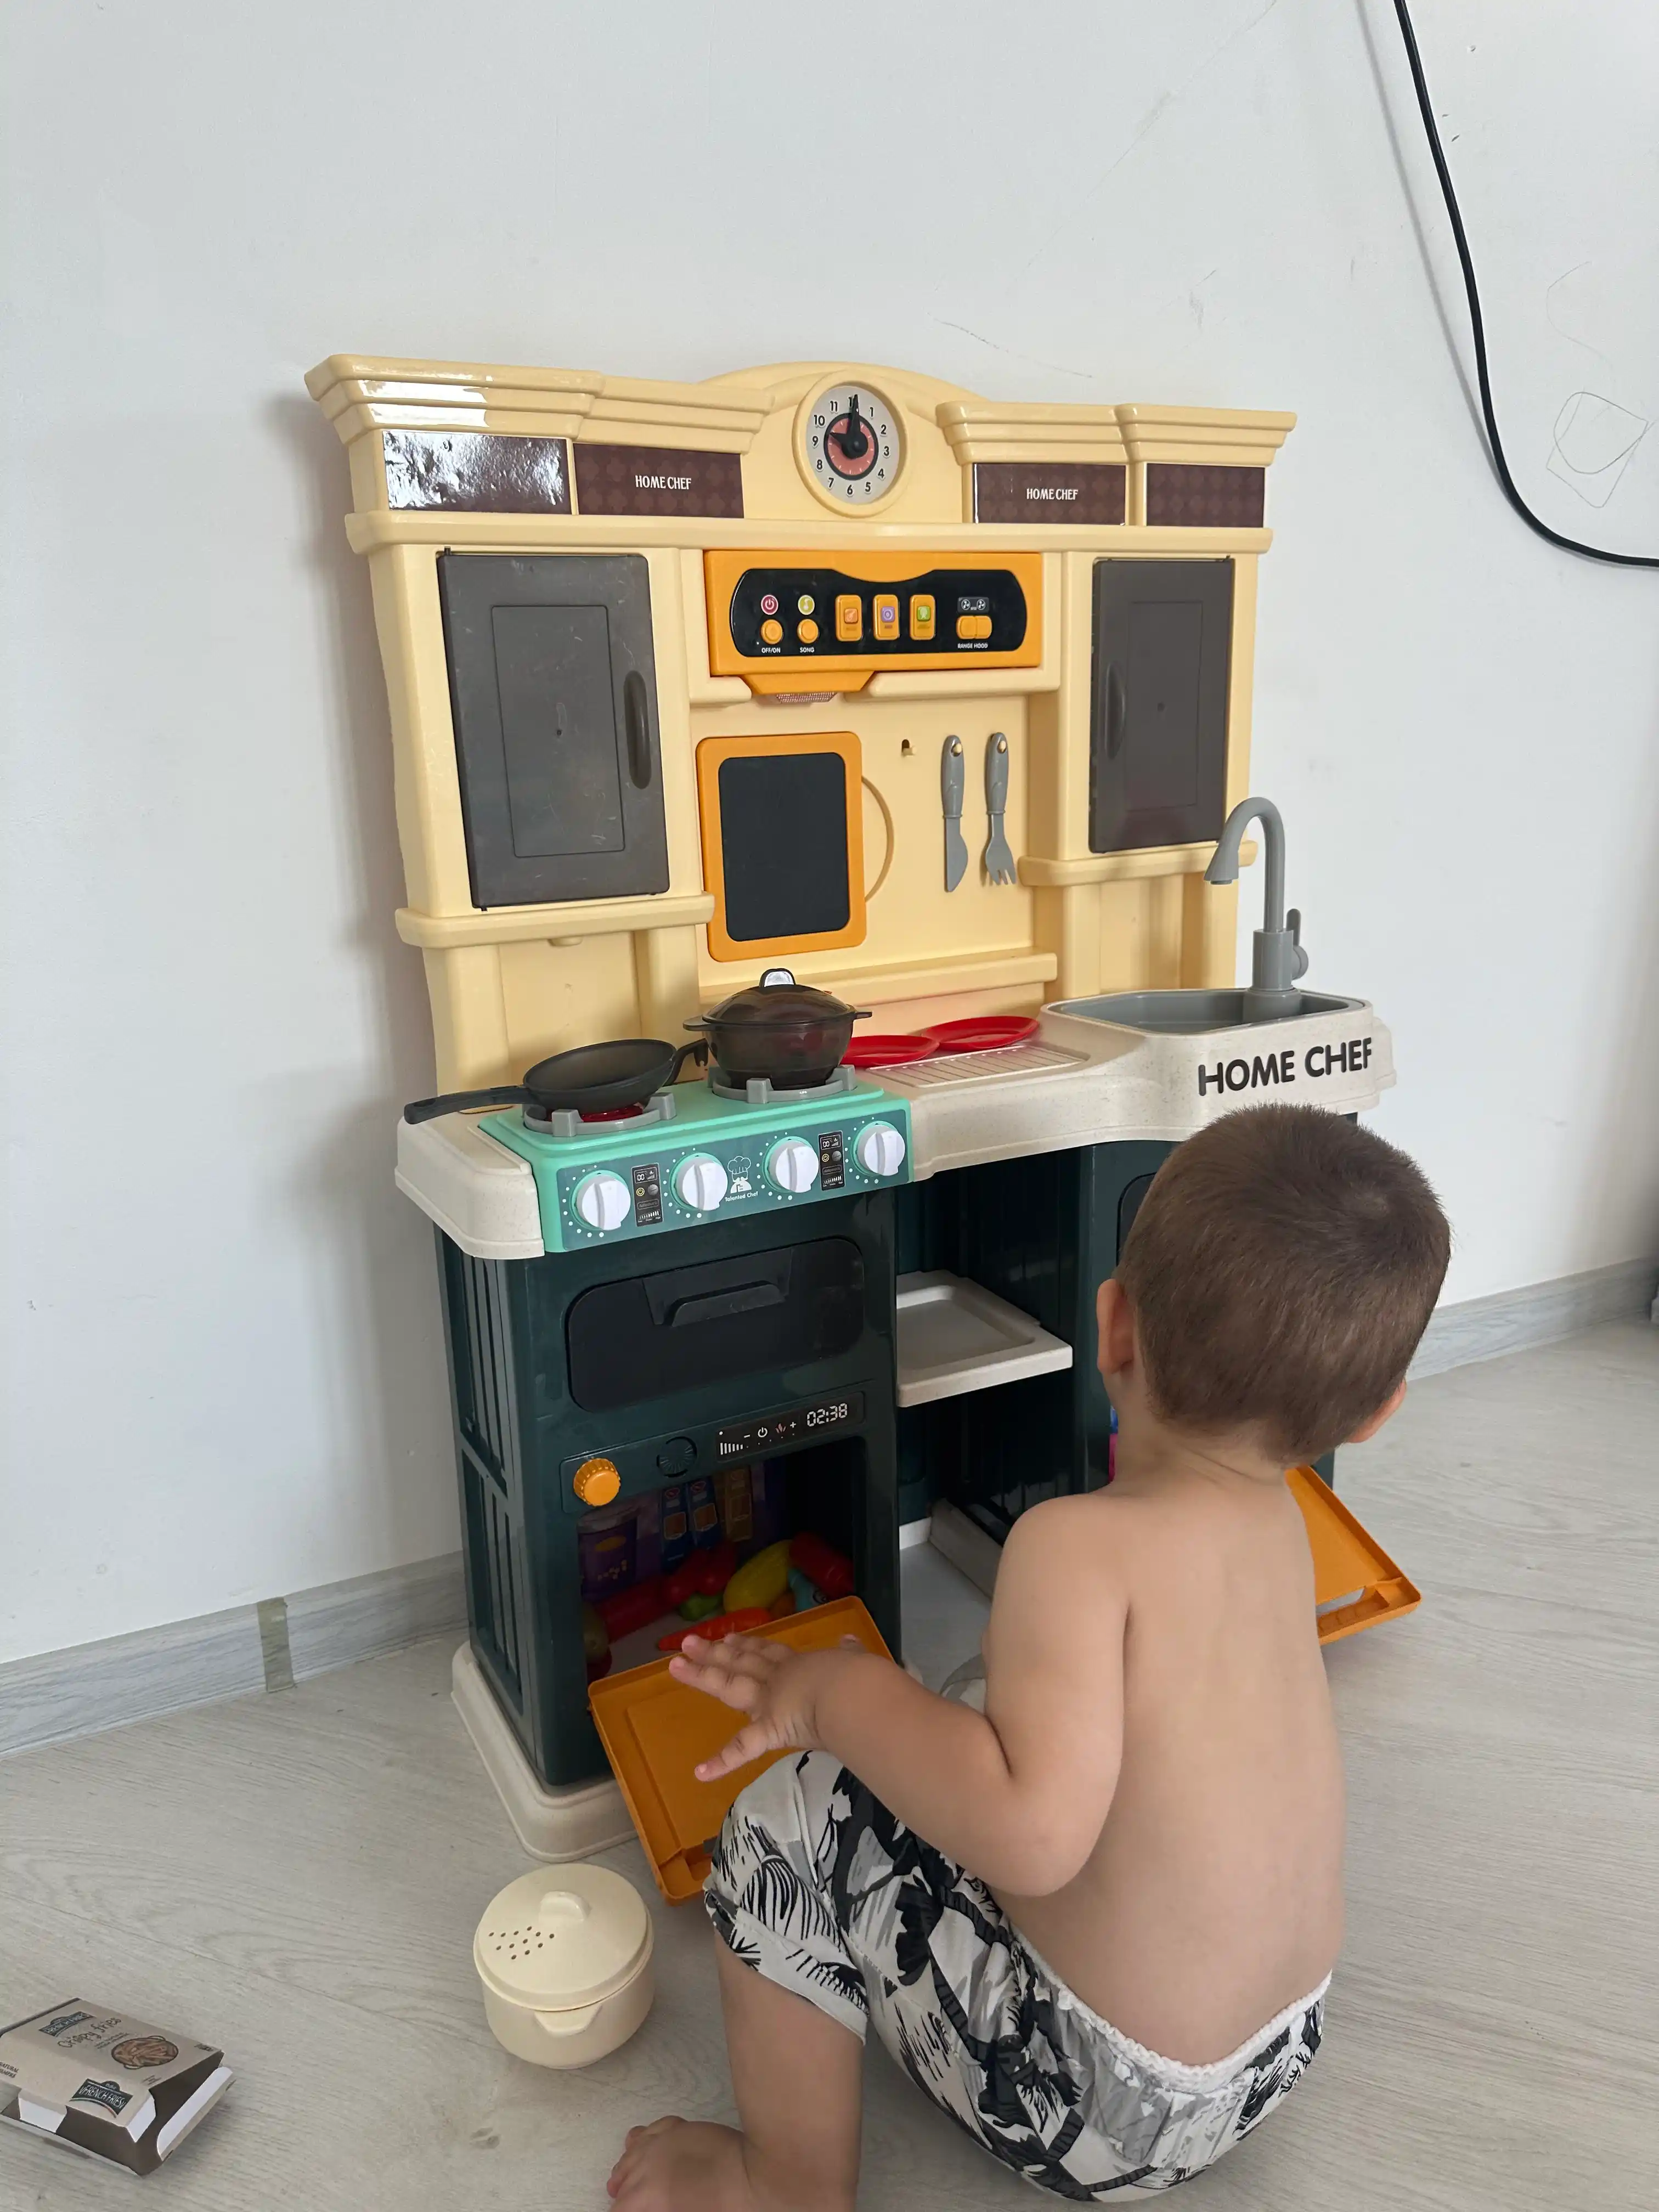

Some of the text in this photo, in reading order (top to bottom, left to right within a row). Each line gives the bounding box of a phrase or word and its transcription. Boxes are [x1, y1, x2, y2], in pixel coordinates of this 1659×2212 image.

[830, 400, 838, 411] 11
[870, 407, 874, 417] 1
[814, 415, 825, 426] 10
[881, 425, 887, 435] 2
[812, 436, 819, 446] 9
[884, 446, 889, 456] 3
[816, 459, 823, 470] 8
[878, 469, 884, 478] 4
[635, 475, 692, 490] HOME CHEF
[828, 478, 834, 488] 7
[865, 482, 871, 492] 5
[847, 484, 853, 494] 6
[1026, 488, 1079, 500] HOME CHEF
[1198, 1037, 1372, 1096] HOME CHEF
[725, 1193, 746, 1202] Talented
[806, 1403, 848, 1427] 02:38
